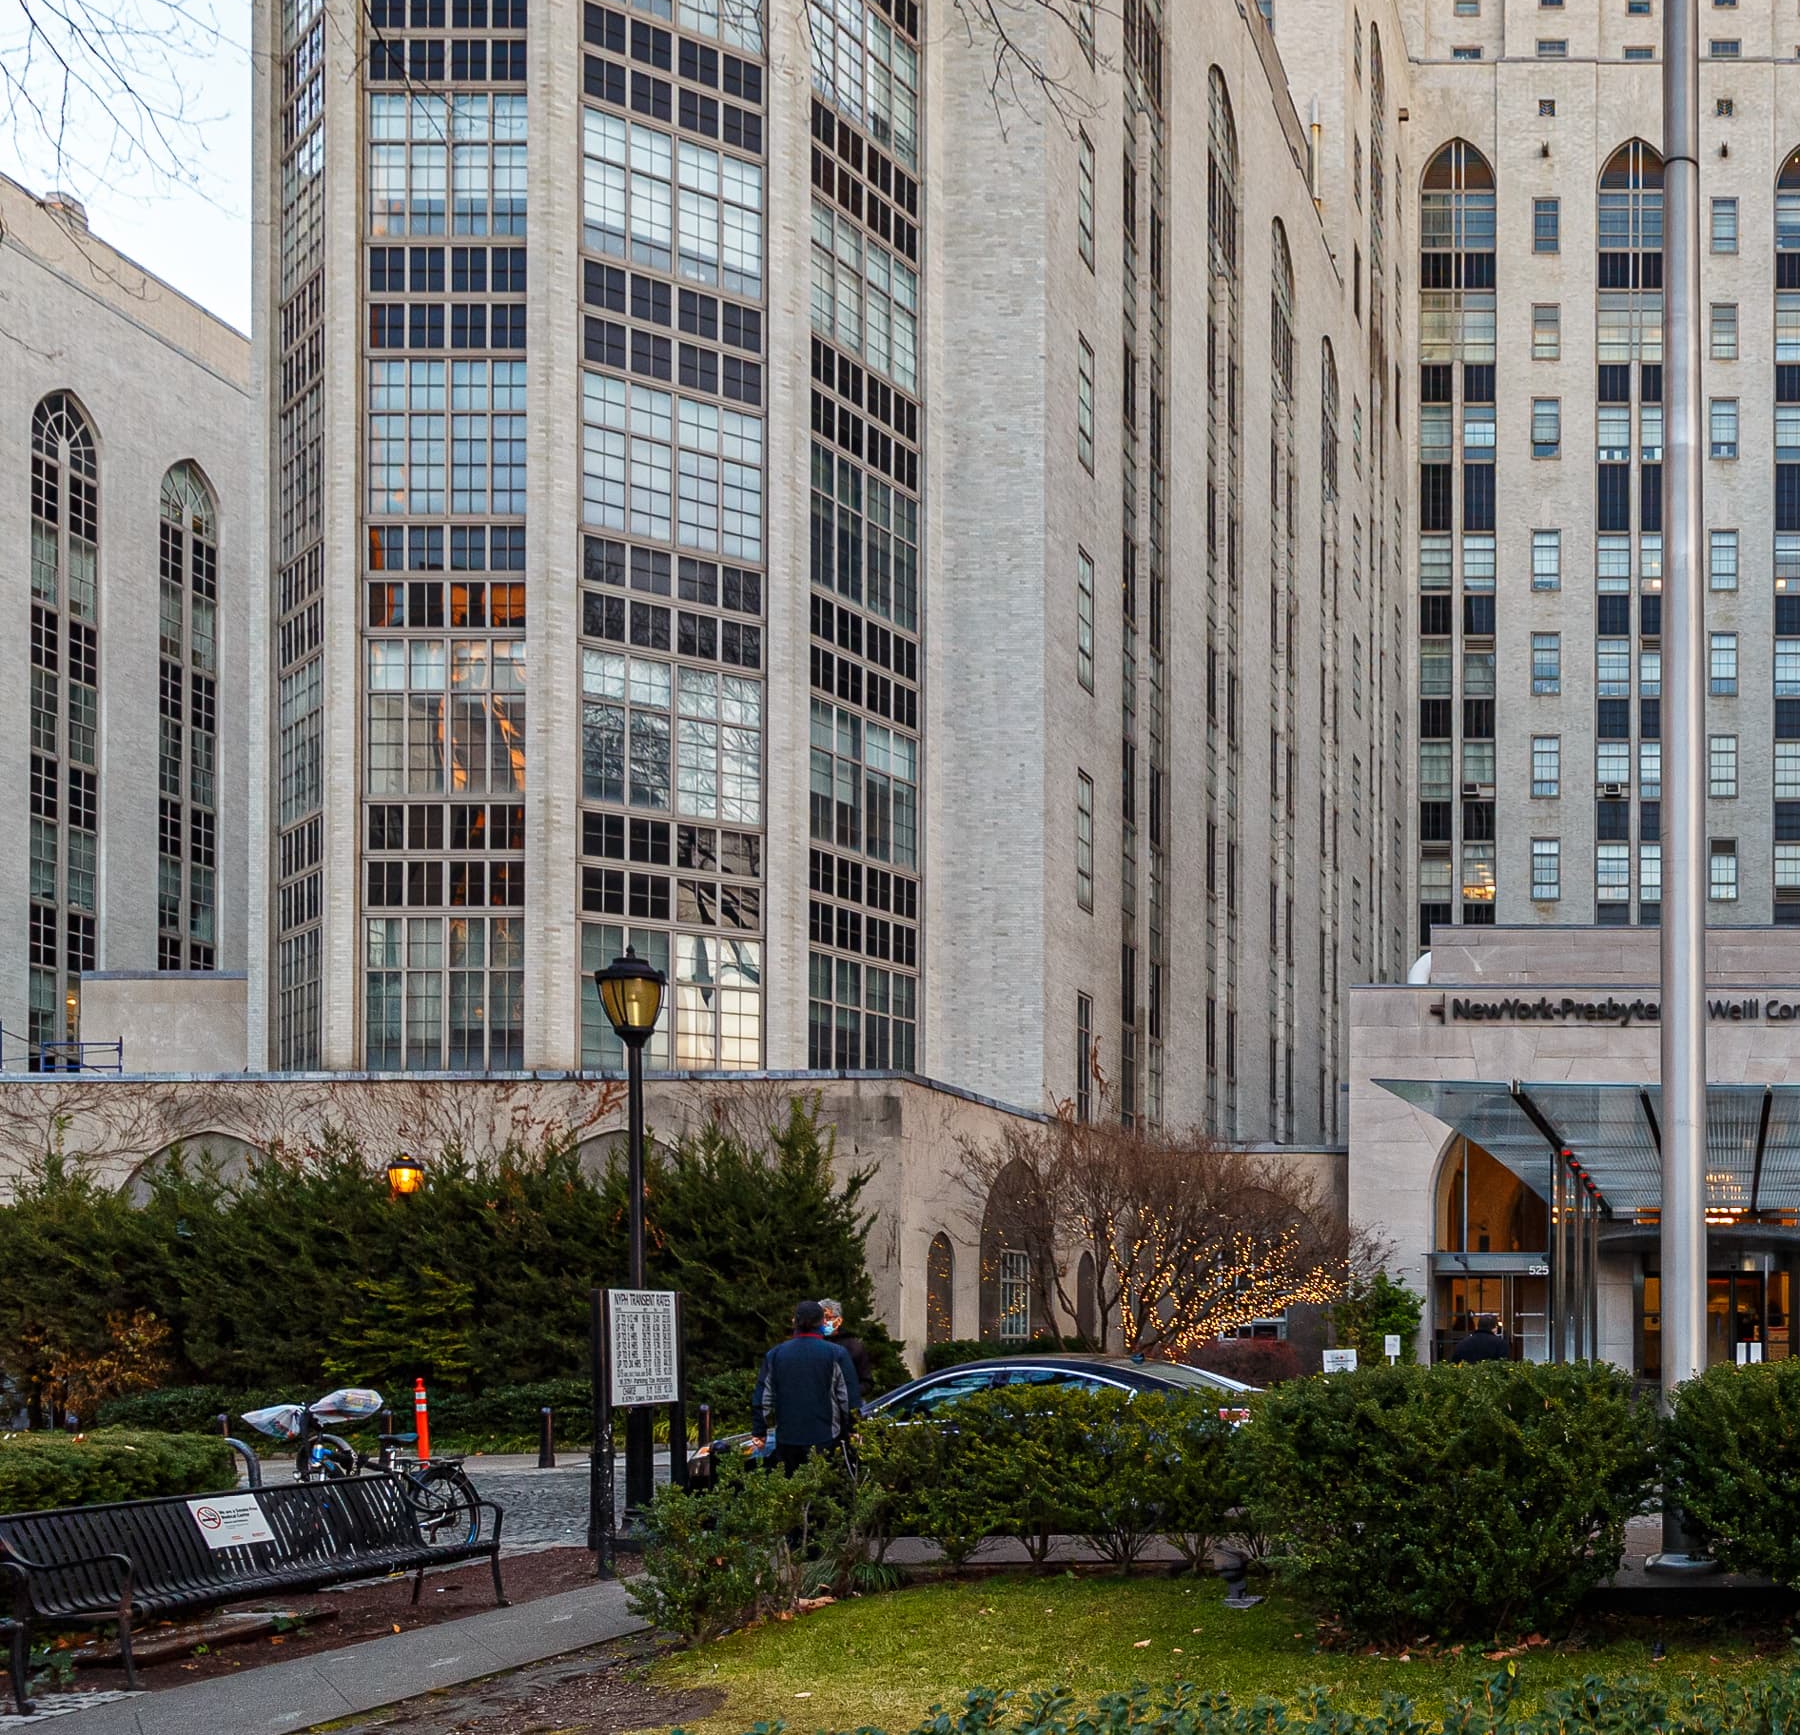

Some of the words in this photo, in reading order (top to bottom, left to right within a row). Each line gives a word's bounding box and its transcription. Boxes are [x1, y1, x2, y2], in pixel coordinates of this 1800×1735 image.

[1452, 997, 1661, 1026] NewYork-Presbyte
[1708, 999, 1759, 1020] Weill
[1528, 1265, 1549, 1275] 525
[656, 1294, 671, 1307] RATES
